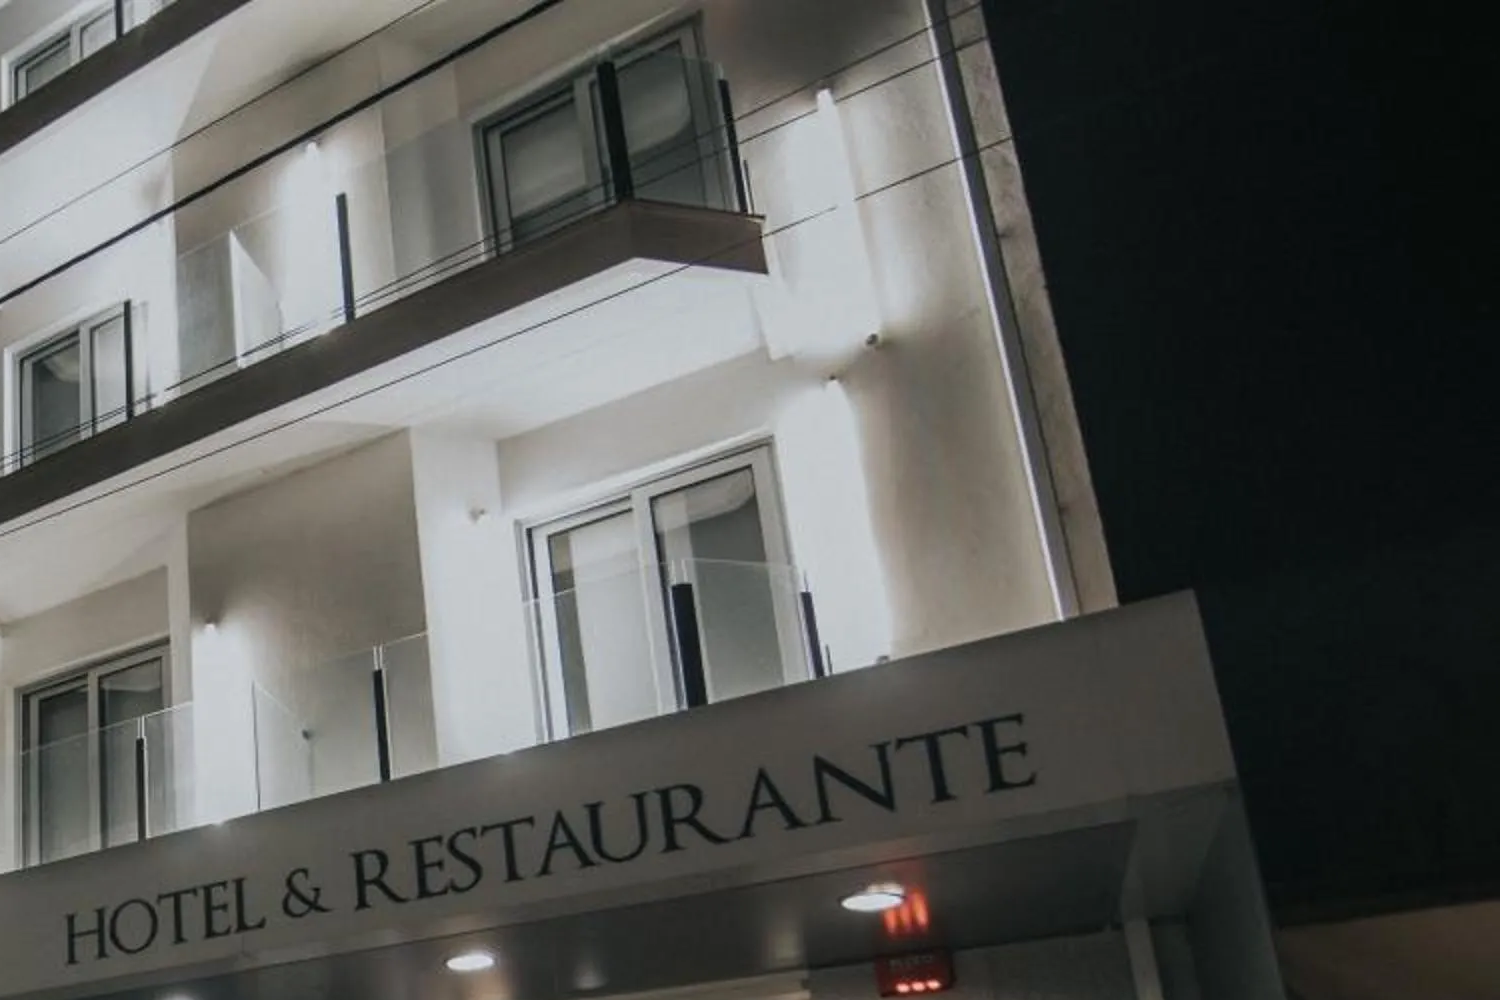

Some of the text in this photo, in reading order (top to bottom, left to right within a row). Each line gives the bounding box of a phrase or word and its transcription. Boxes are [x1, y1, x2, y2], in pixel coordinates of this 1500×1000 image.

[65, 712, 1038, 966] HOTEL & RESTAURANTE
